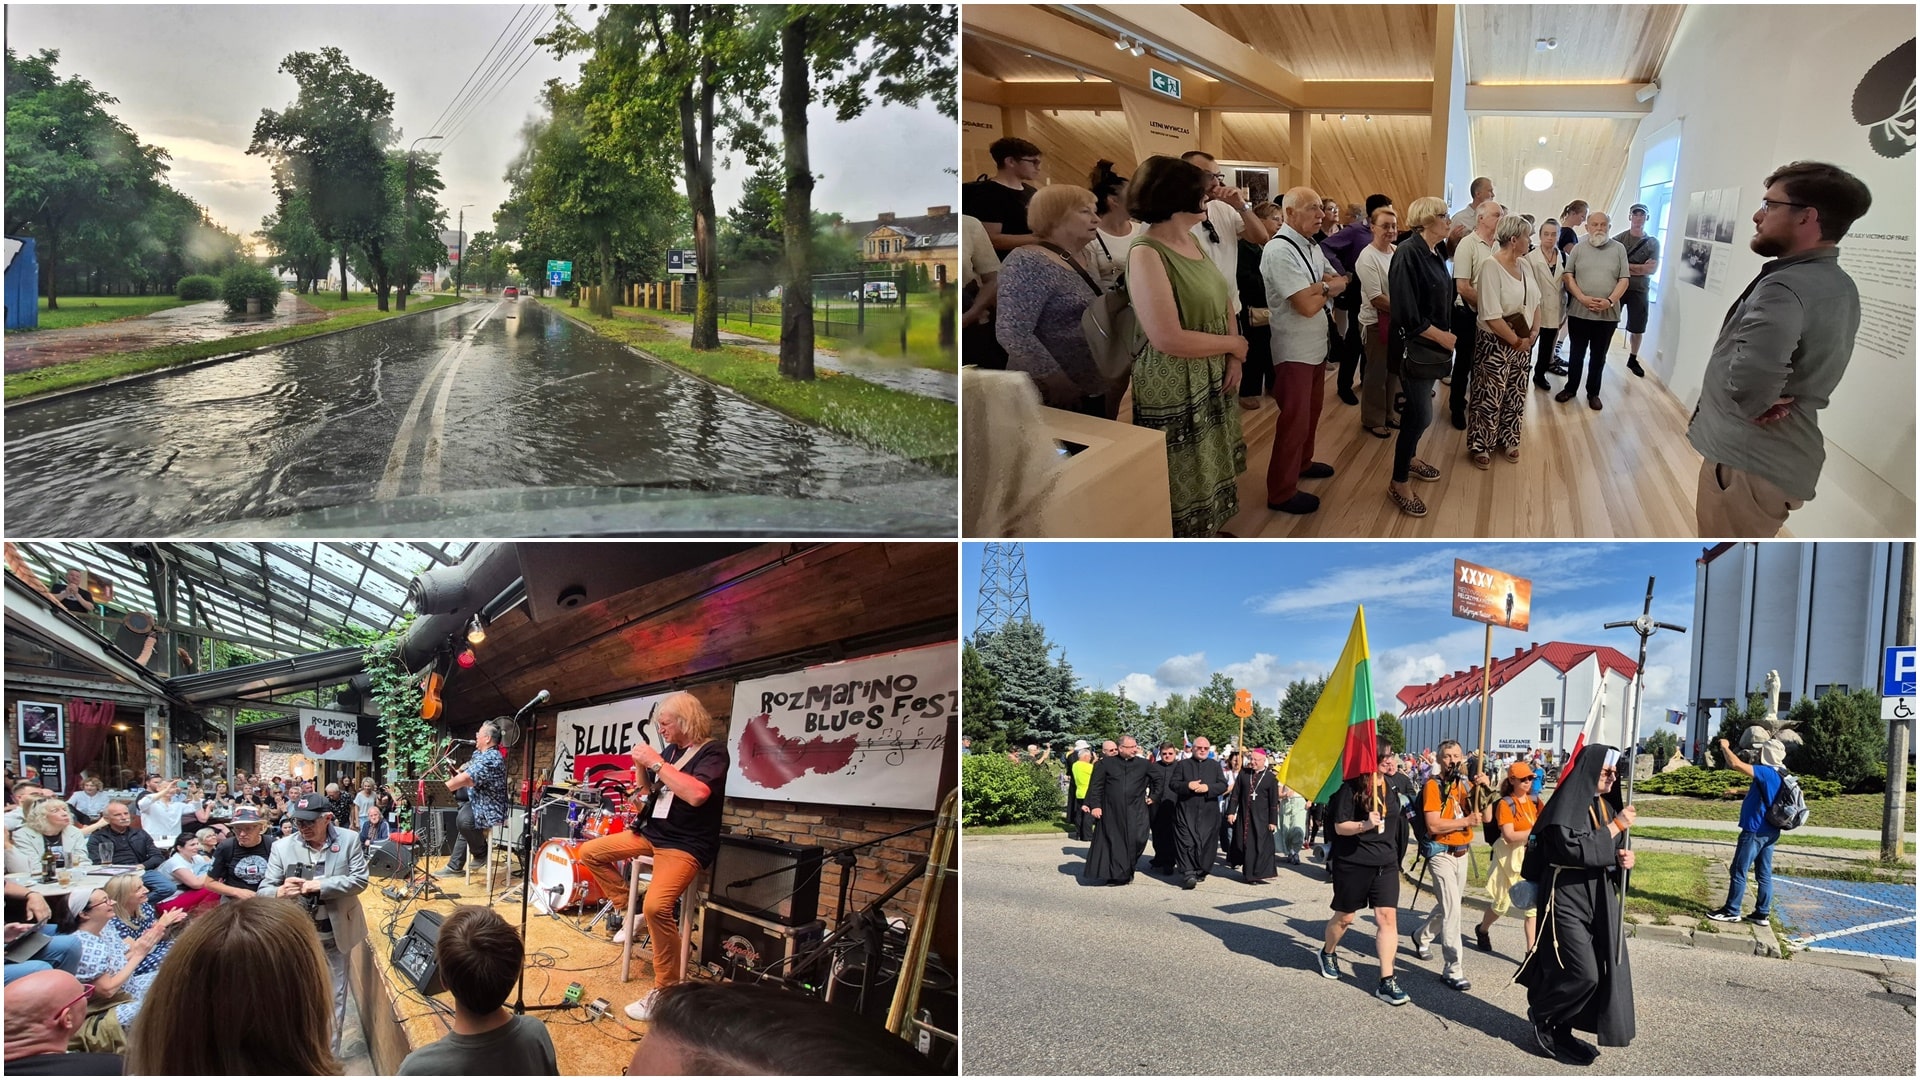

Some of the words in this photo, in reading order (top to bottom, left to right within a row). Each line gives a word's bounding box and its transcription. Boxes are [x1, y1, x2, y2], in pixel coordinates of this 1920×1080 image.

[1460, 566, 1495, 590] XXXV
[1894, 650, 1917, 682] P
[572, 702, 657, 755] BLUES
